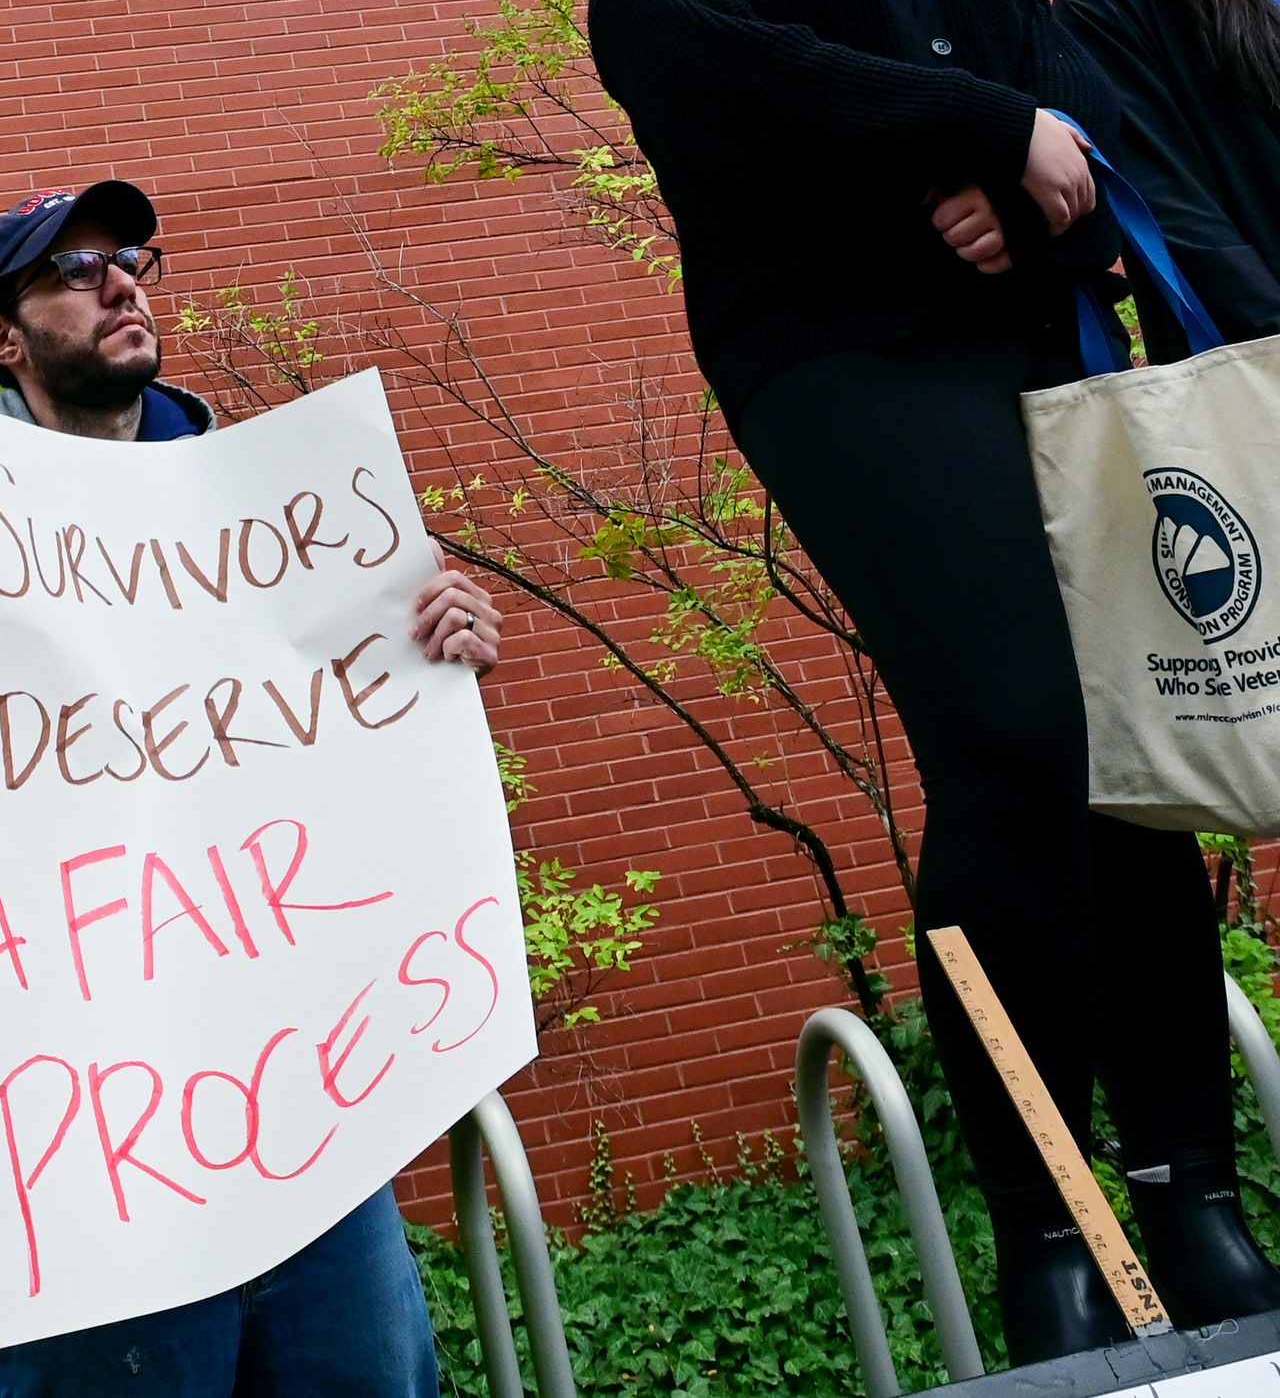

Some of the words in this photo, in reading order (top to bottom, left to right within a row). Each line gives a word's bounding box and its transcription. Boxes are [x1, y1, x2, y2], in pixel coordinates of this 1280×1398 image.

[1150, 476, 1245, 543] MANAGEMENT
[1219, 552, 1254, 627] PROGRAM
[1155, 677, 1200, 696] Who
[60, 819, 395, 1002] FAIR
[944, 950, 958, 964] 35
[974, 1008, 988, 1022] 33
[1006, 1069, 1020, 1083] 31
[1022, 1099, 1036, 1114] 30
[1039, 1132, 1054, 1148] 29
[1056, 1164, 1071, 1181] 28
[1074, 1200, 1089, 1215] 27
[1043, 1226, 1081, 1241] NAUTIC
[1091, 1233, 1108, 1250] 26
[1111, 1269, 1126, 1286] 25
[1130, 1306, 1146, 1323] 24
